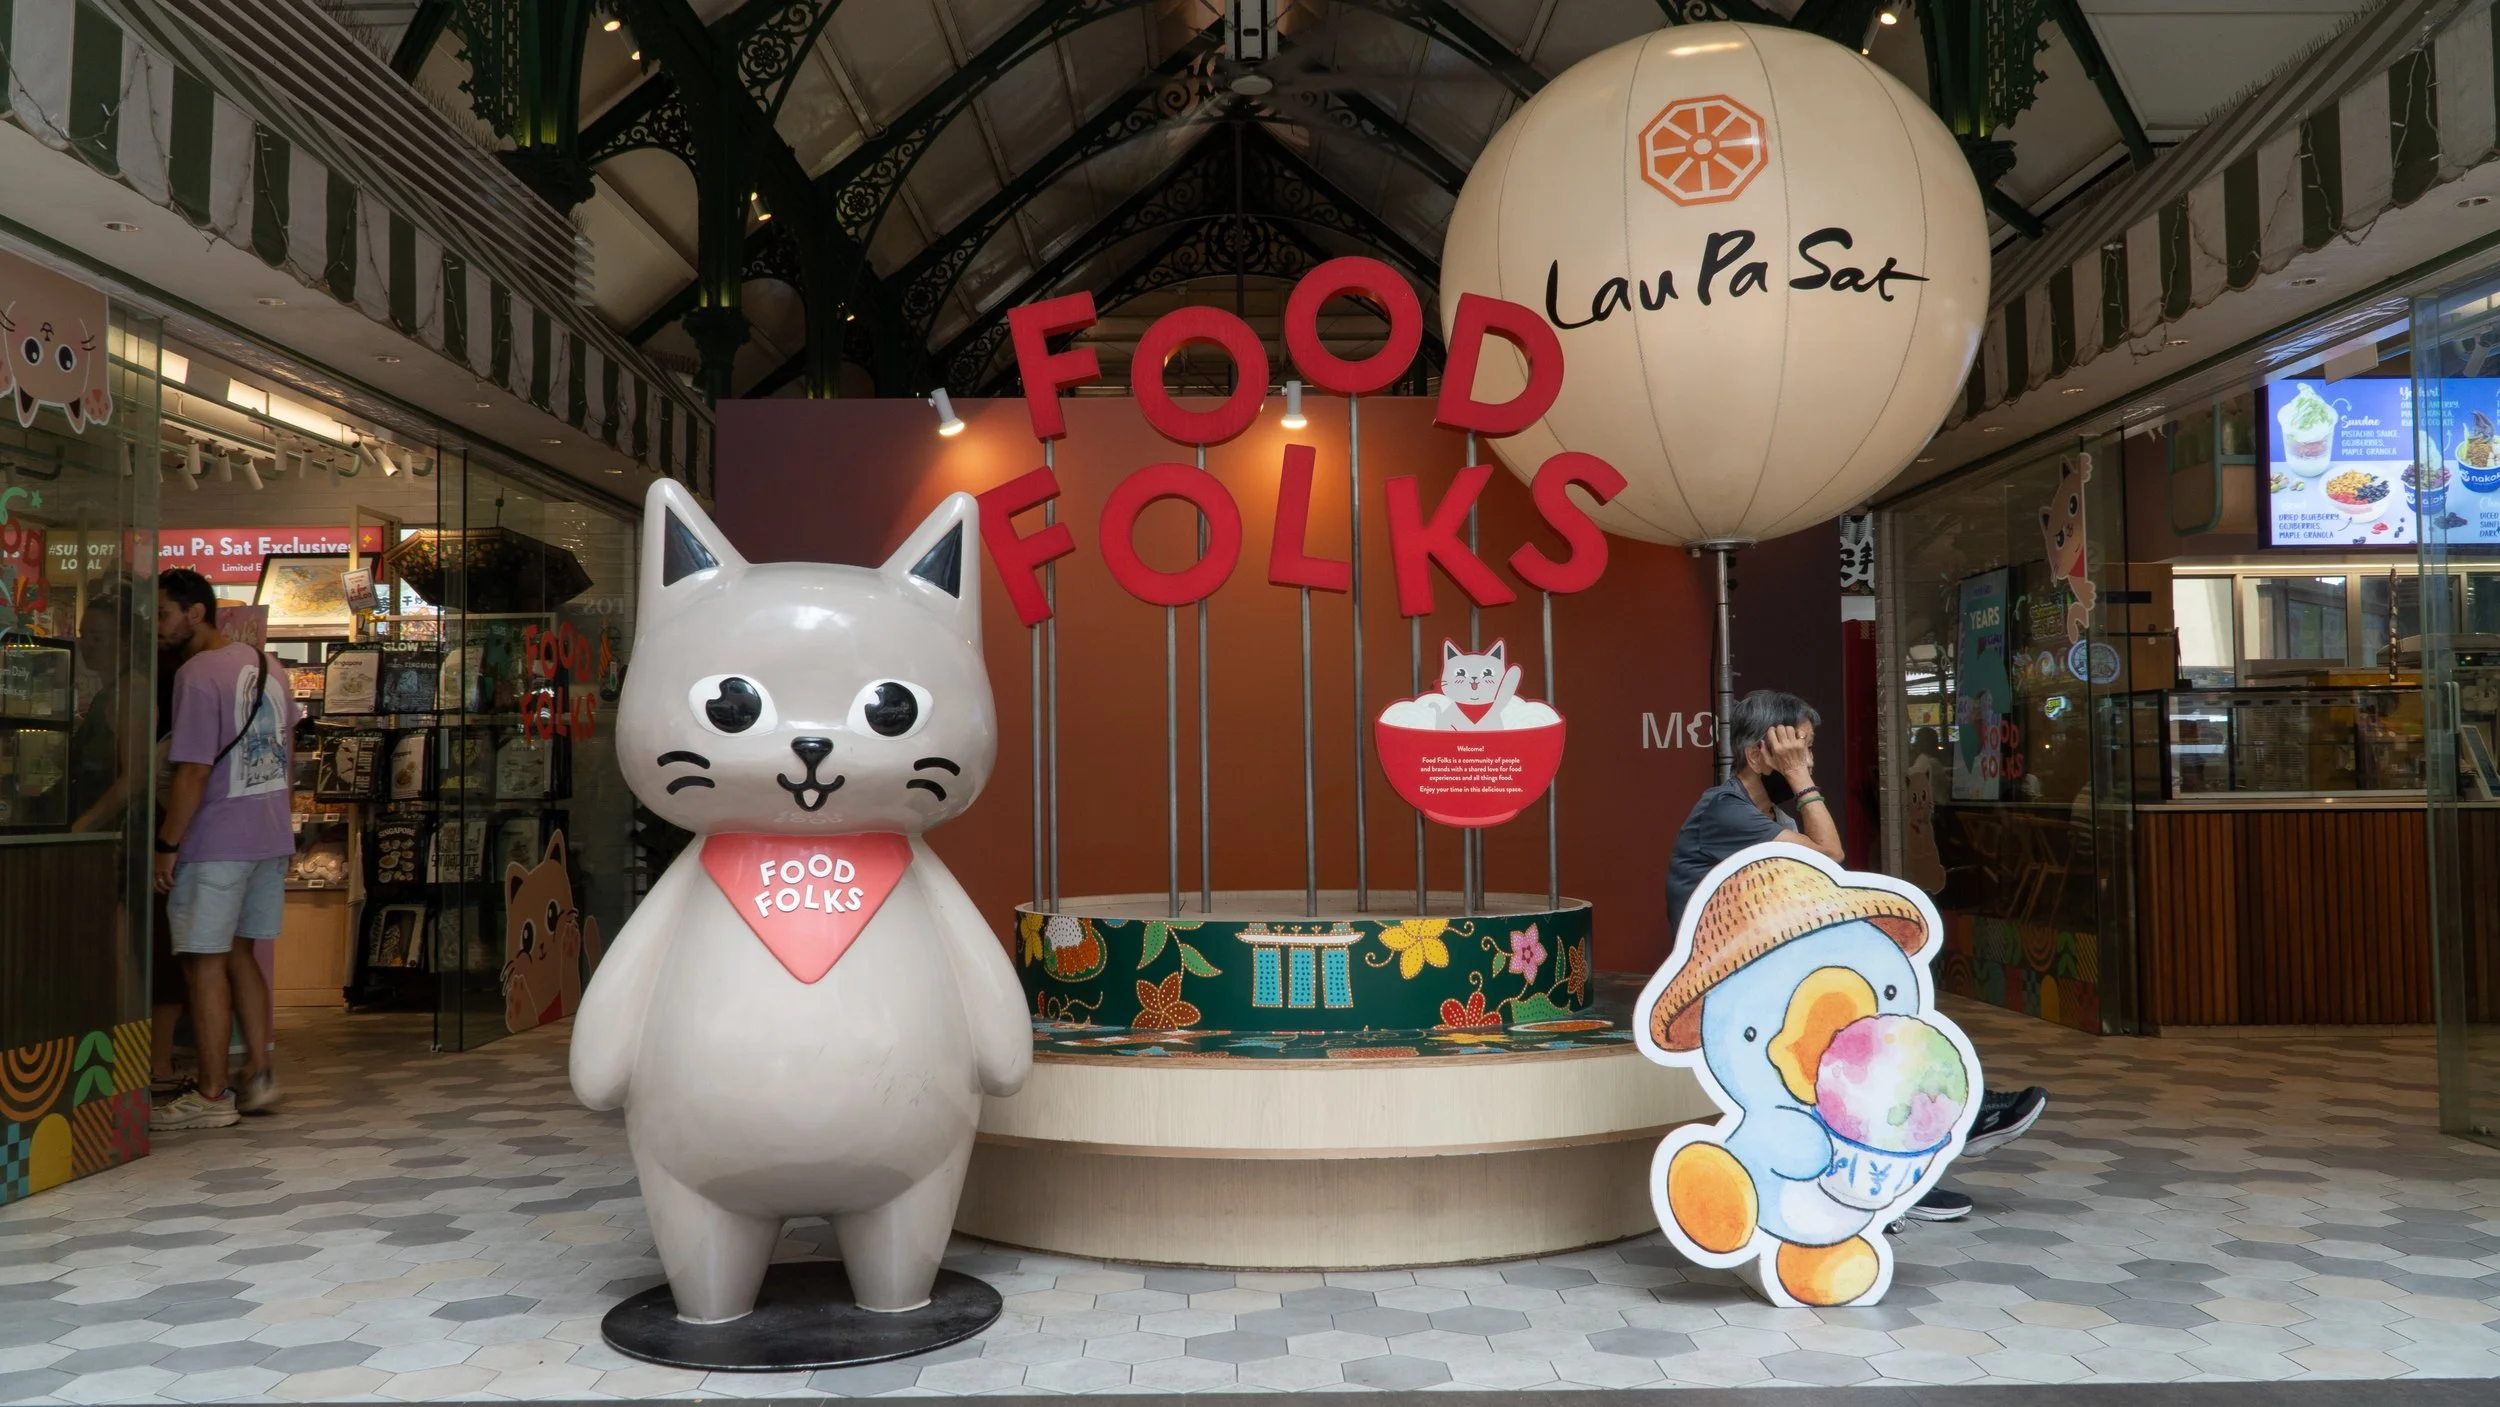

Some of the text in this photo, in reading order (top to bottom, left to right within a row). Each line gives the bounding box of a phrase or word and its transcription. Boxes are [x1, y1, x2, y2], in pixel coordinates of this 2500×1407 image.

[1546, 227, 1930, 329] Lau Pa Sat
[1007, 255, 1565, 447] FOOD
[2341, 415, 2380, 428] Sundae
[2341, 430, 2375, 438] PISTACHIO
[2341, 448, 2397, 456] MAPLE GRANOLA
[2278, 513, 2299, 521] DRIED
[975, 444, 1628, 627] FOLKS
[2279, 531, 2334, 539] MAPLE GRANOLA
[191, 538, 214, 556] Pa
[220, 537, 251, 555] Sat
[61, 558, 102, 570] LOAL
[222, 564, 254, 572] Limited
[1970, 606, 2000, 630] YEARS
[383, 642, 418, 651] GLOW
[525, 619, 591, 683] FOOD
[521, 687, 597, 746] FOLKS
[1981, 720, 2019, 751] FOOD
[1462, 757, 1493, 765] community
[1501, 757, 1520, 765] people
[1481, 775, 1498, 783] things
[1420, 786, 1435, 794] Enjoy
[378, 826, 416, 838] SINGAPORE
[760, 854, 856, 887] FOOD
[754, 884, 864, 918] FOLKS
